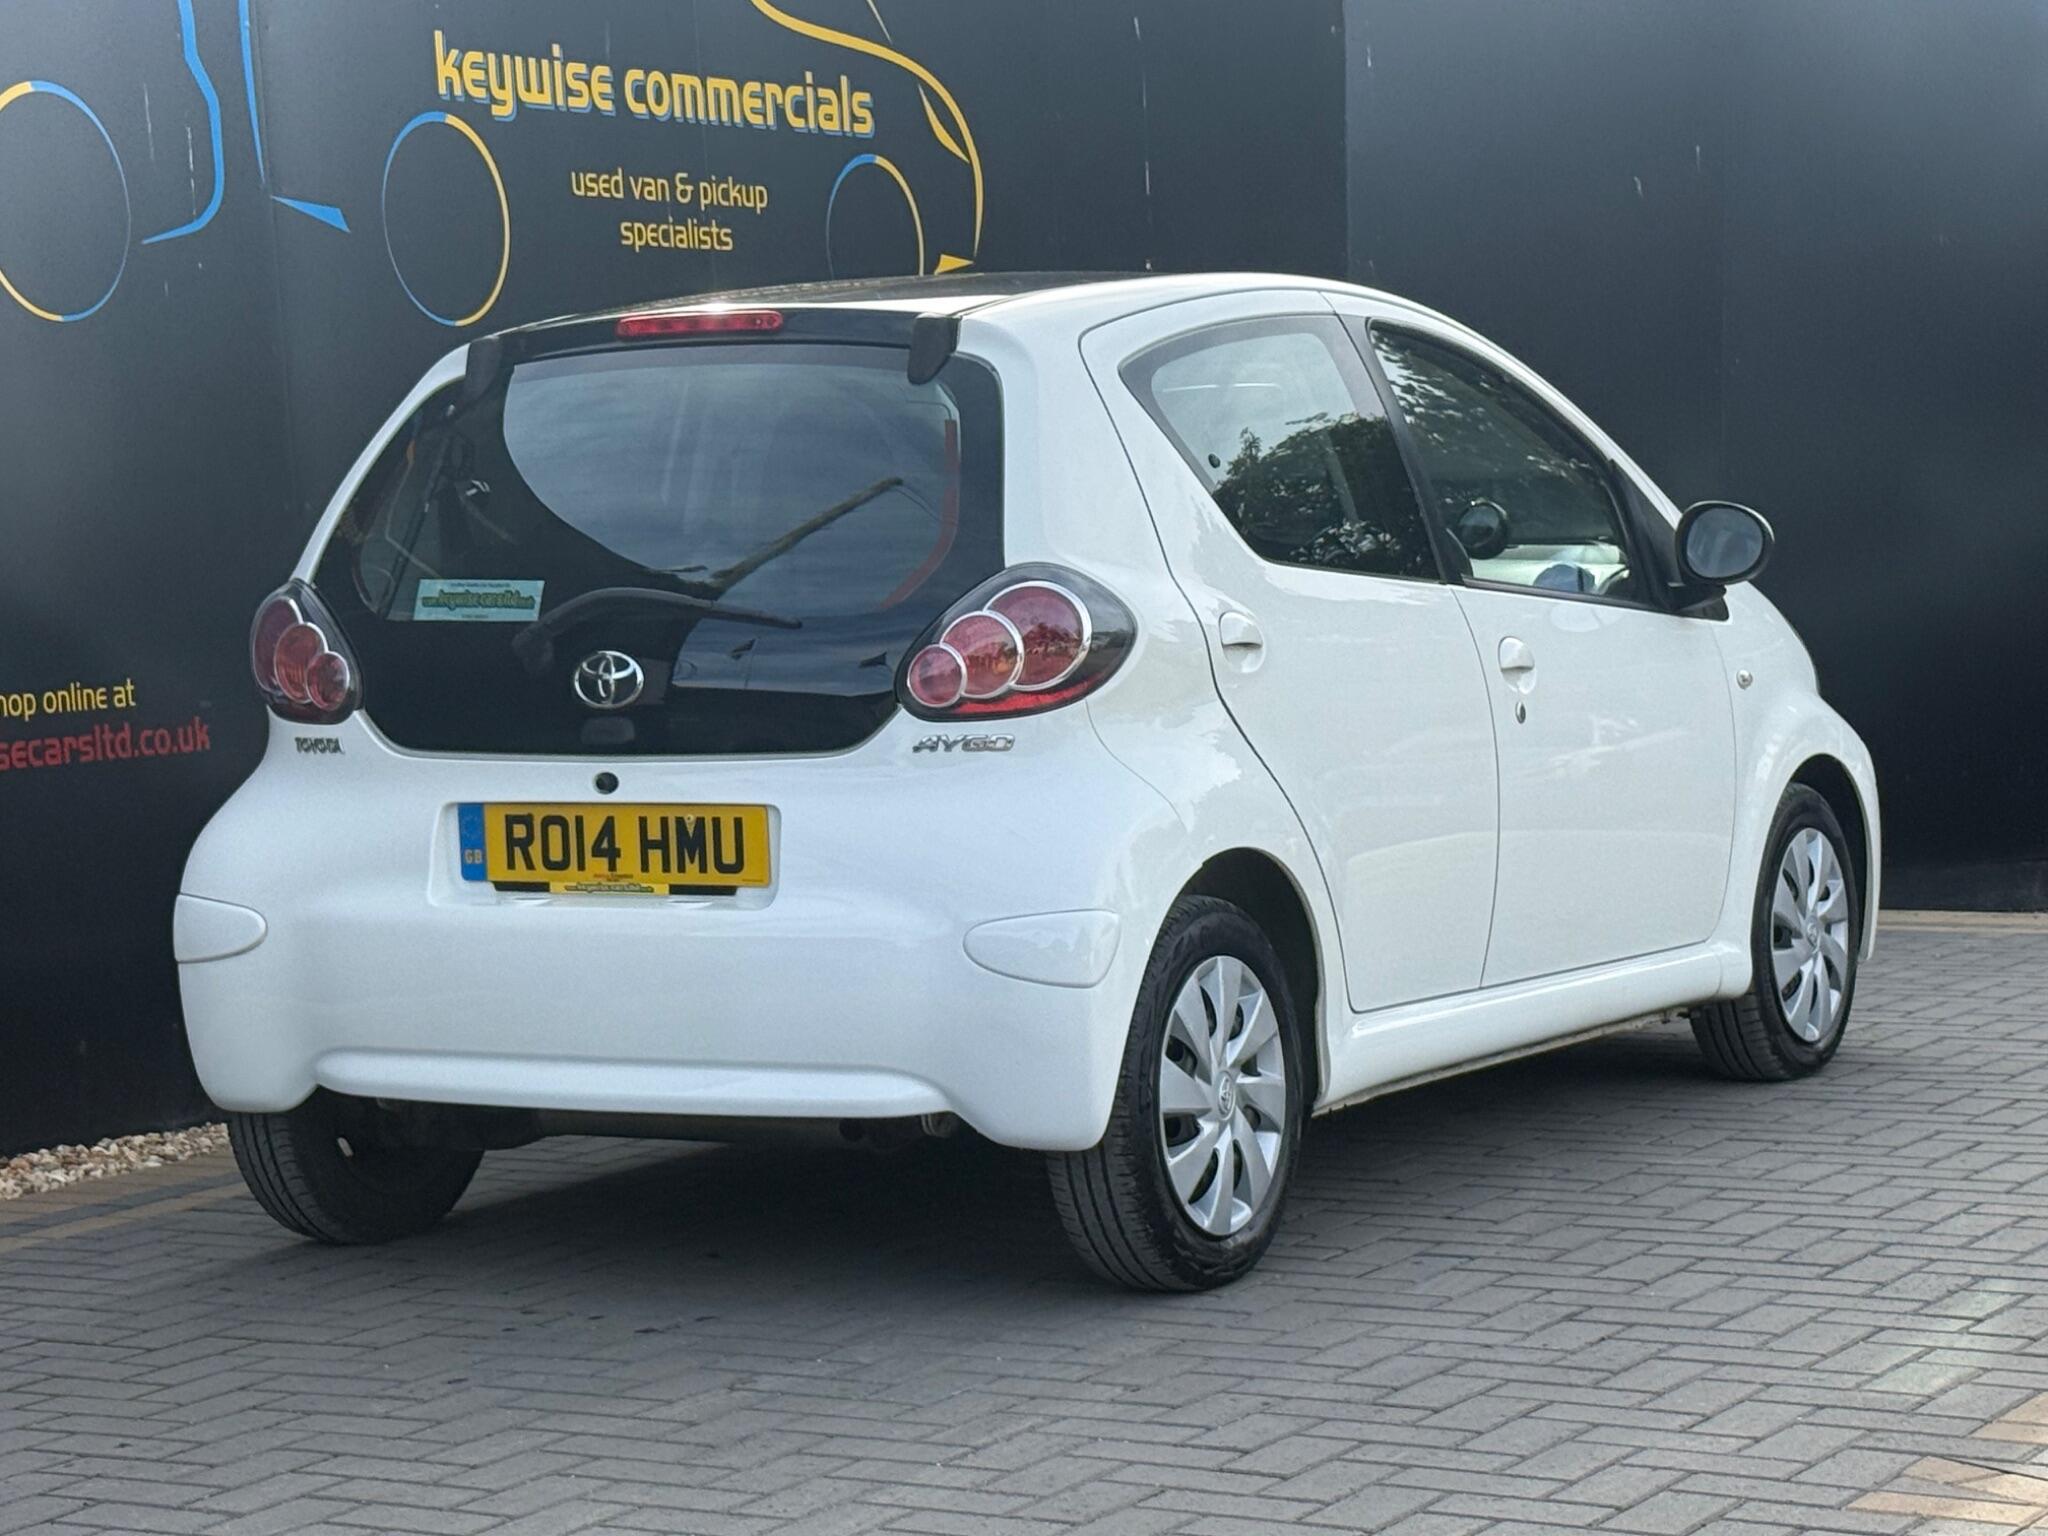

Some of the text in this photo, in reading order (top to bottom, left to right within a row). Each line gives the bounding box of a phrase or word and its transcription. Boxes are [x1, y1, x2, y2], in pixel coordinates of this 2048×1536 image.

[434, 30, 876, 138] keywise commercials
[571, 168, 769, 212] used van & pickup
[620, 217, 734, 252] specialists
[43, 682, 108, 712] online
[113, 678, 136, 708] at
[295, 737, 344, 754] TOYOTA
[912, 734, 1016, 753] AYGO
[464, 849, 483, 865] GB
[505, 813, 746, 875] RO14 HMU
